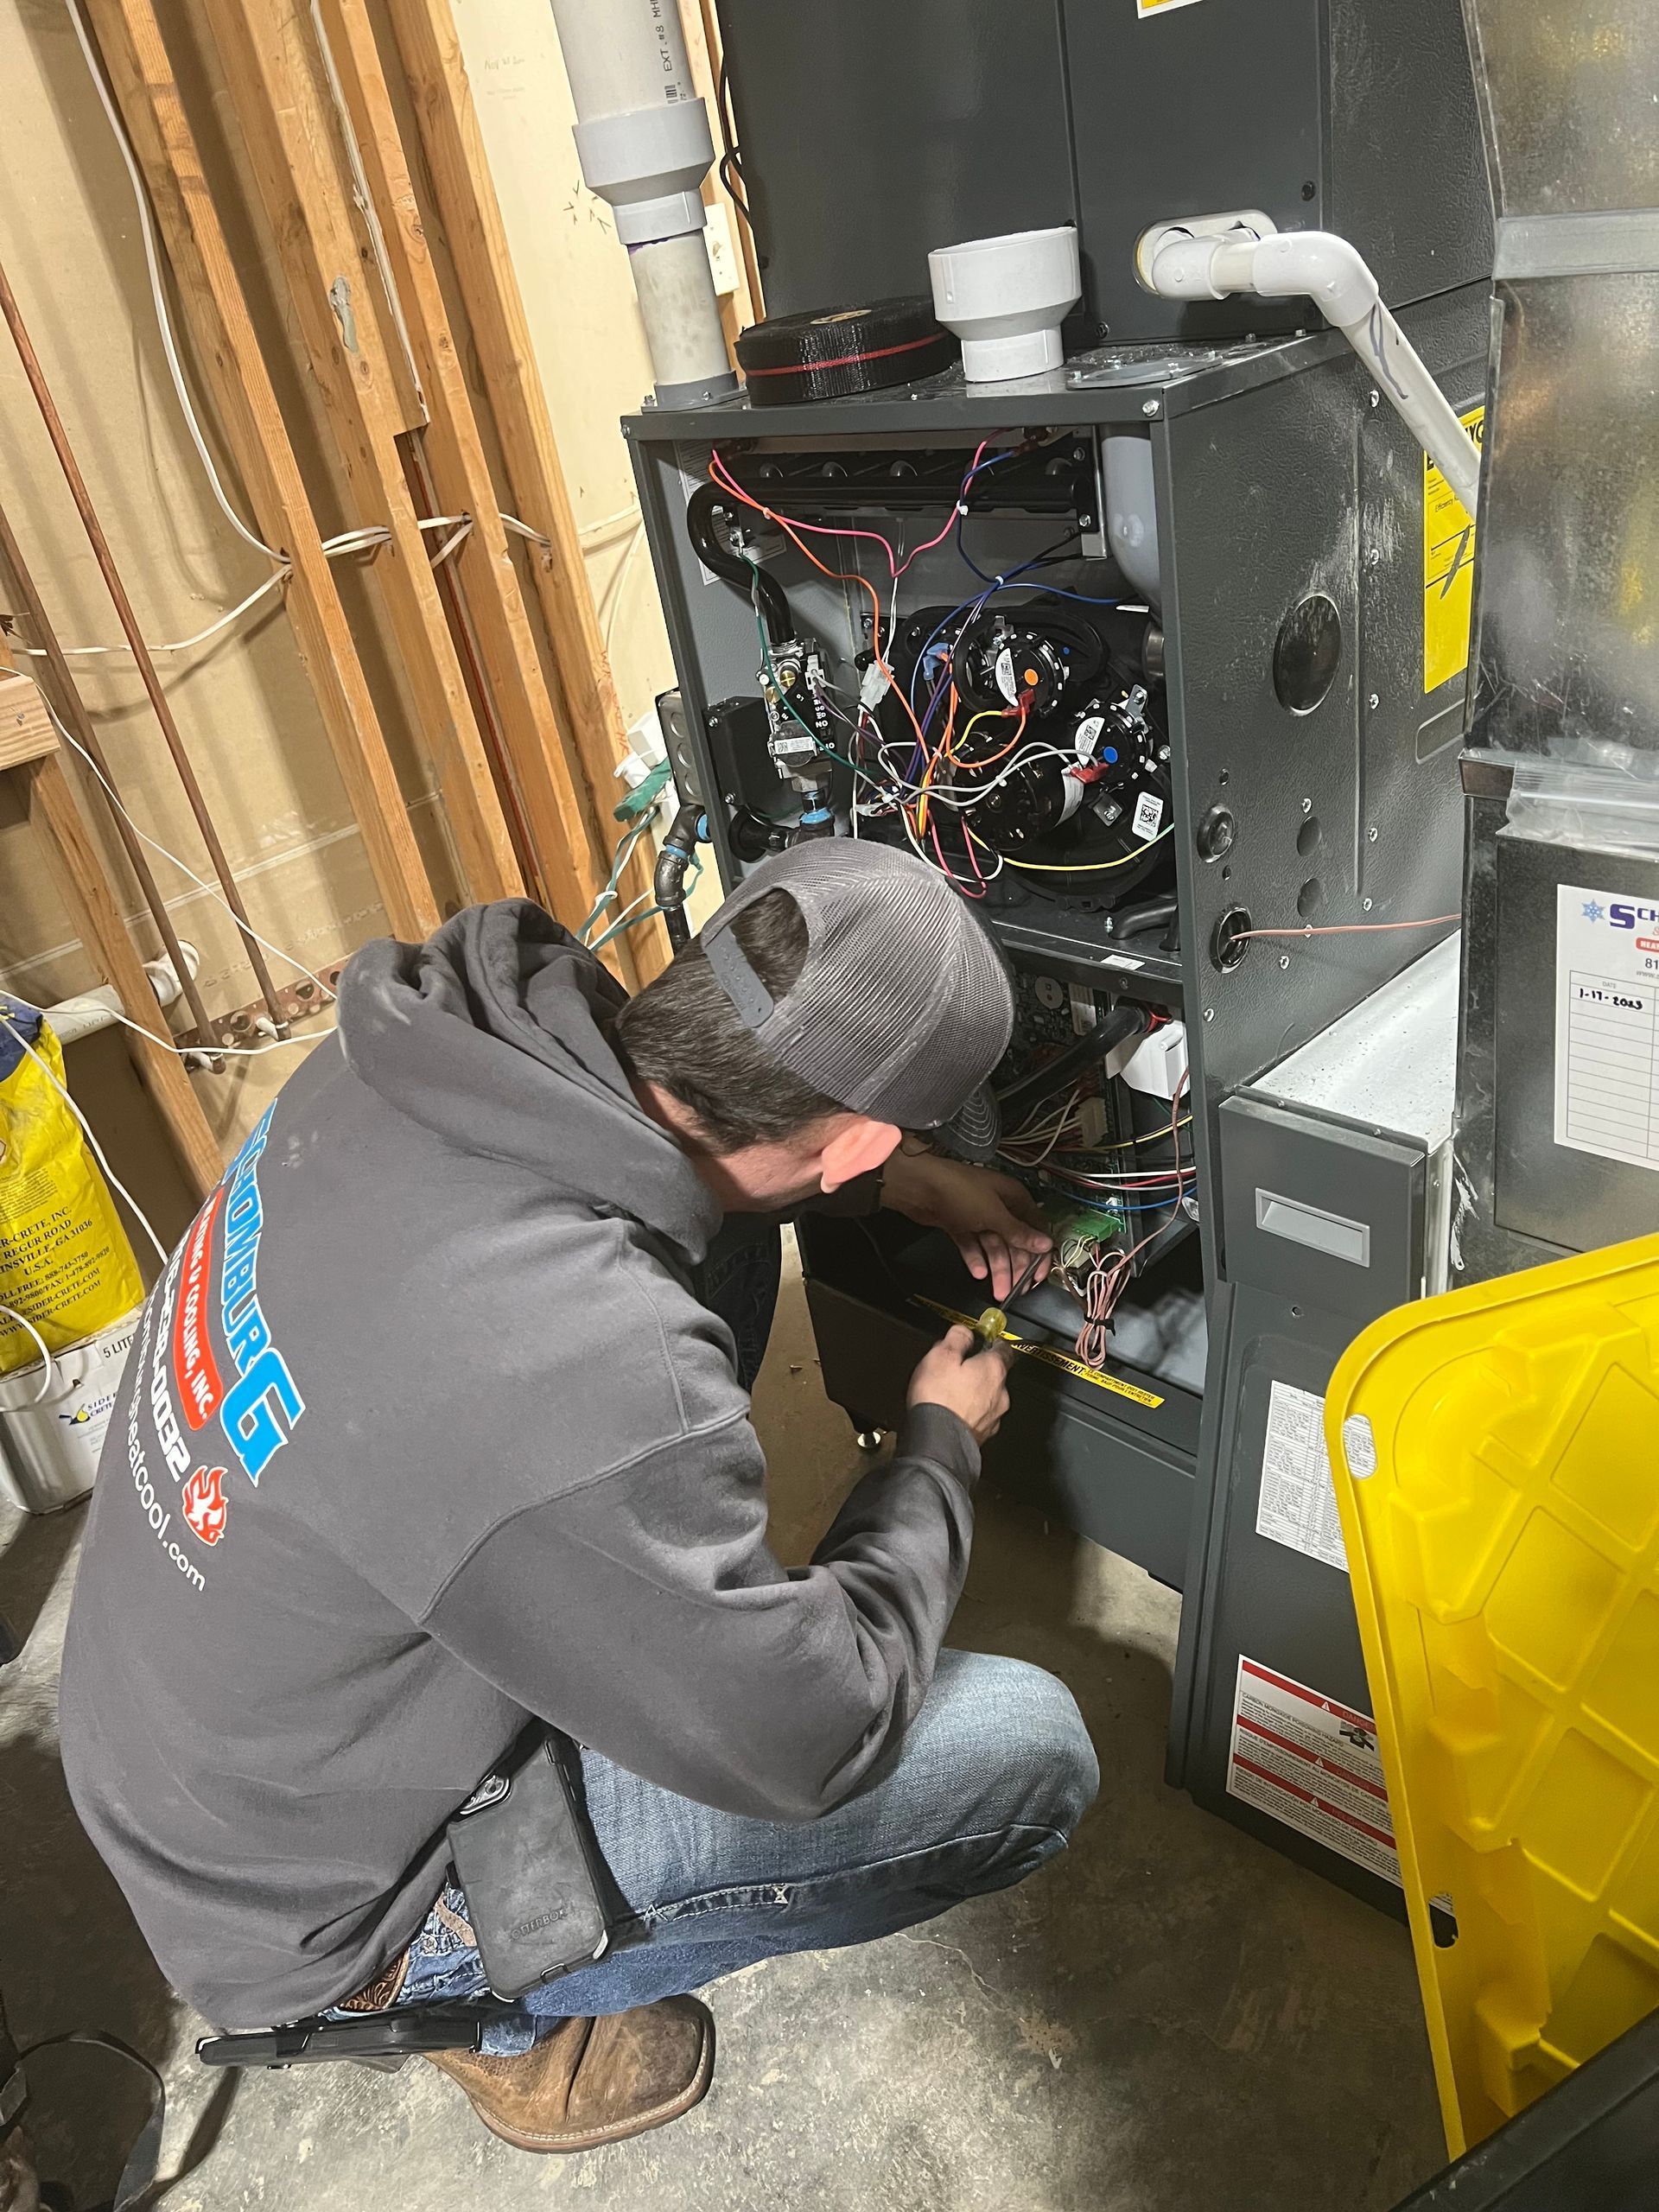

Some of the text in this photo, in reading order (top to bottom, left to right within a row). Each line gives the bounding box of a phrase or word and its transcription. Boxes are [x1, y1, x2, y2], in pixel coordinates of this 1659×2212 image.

[650, 0, 661, 18] MH
[1602, 981, 1617, 989] DATE
[0, 1205, 72, 1248] R-CRETE, INC.
[3, 1219, 72, 1259] REGUR ROAD
[0, 1243, 55, 1274] INSVILLE,
[55, 1235, 70, 1247] GA
[24, 1259, 54, 1276] U.S.A.
[104, 1334, 134, 1358] 5 LITE
[191, 1369, 214, 1420] INC.
[1342, 1710, 1376, 1731] DANGE
